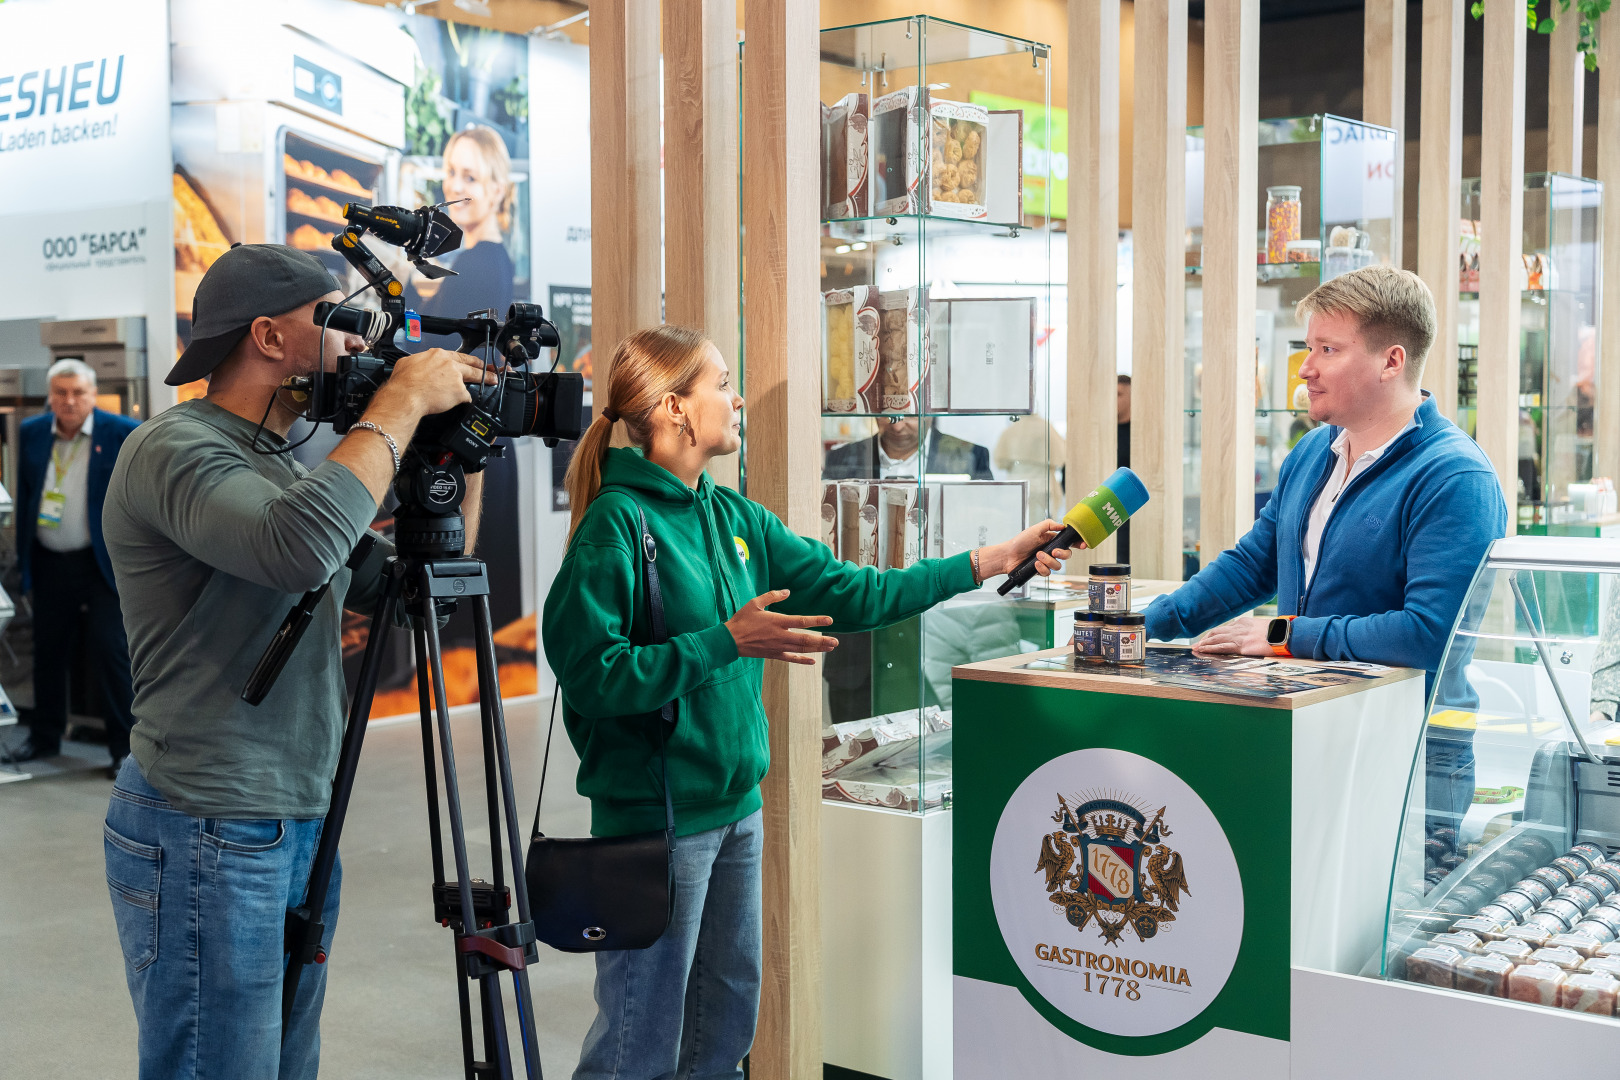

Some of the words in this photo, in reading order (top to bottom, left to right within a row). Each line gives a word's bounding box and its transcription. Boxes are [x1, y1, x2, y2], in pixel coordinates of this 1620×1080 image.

[51, 112, 118, 146] backen!
[43, 235, 77, 259] ООО
[466, 437, 480, 448] SONY
[1084, 802, 1136, 817] GASTRONOMIA
[1092, 847, 1130, 895] 1778
[1035, 943, 1192, 988] GASTRONOMIA
[1083, 971, 1141, 1001] 1778
